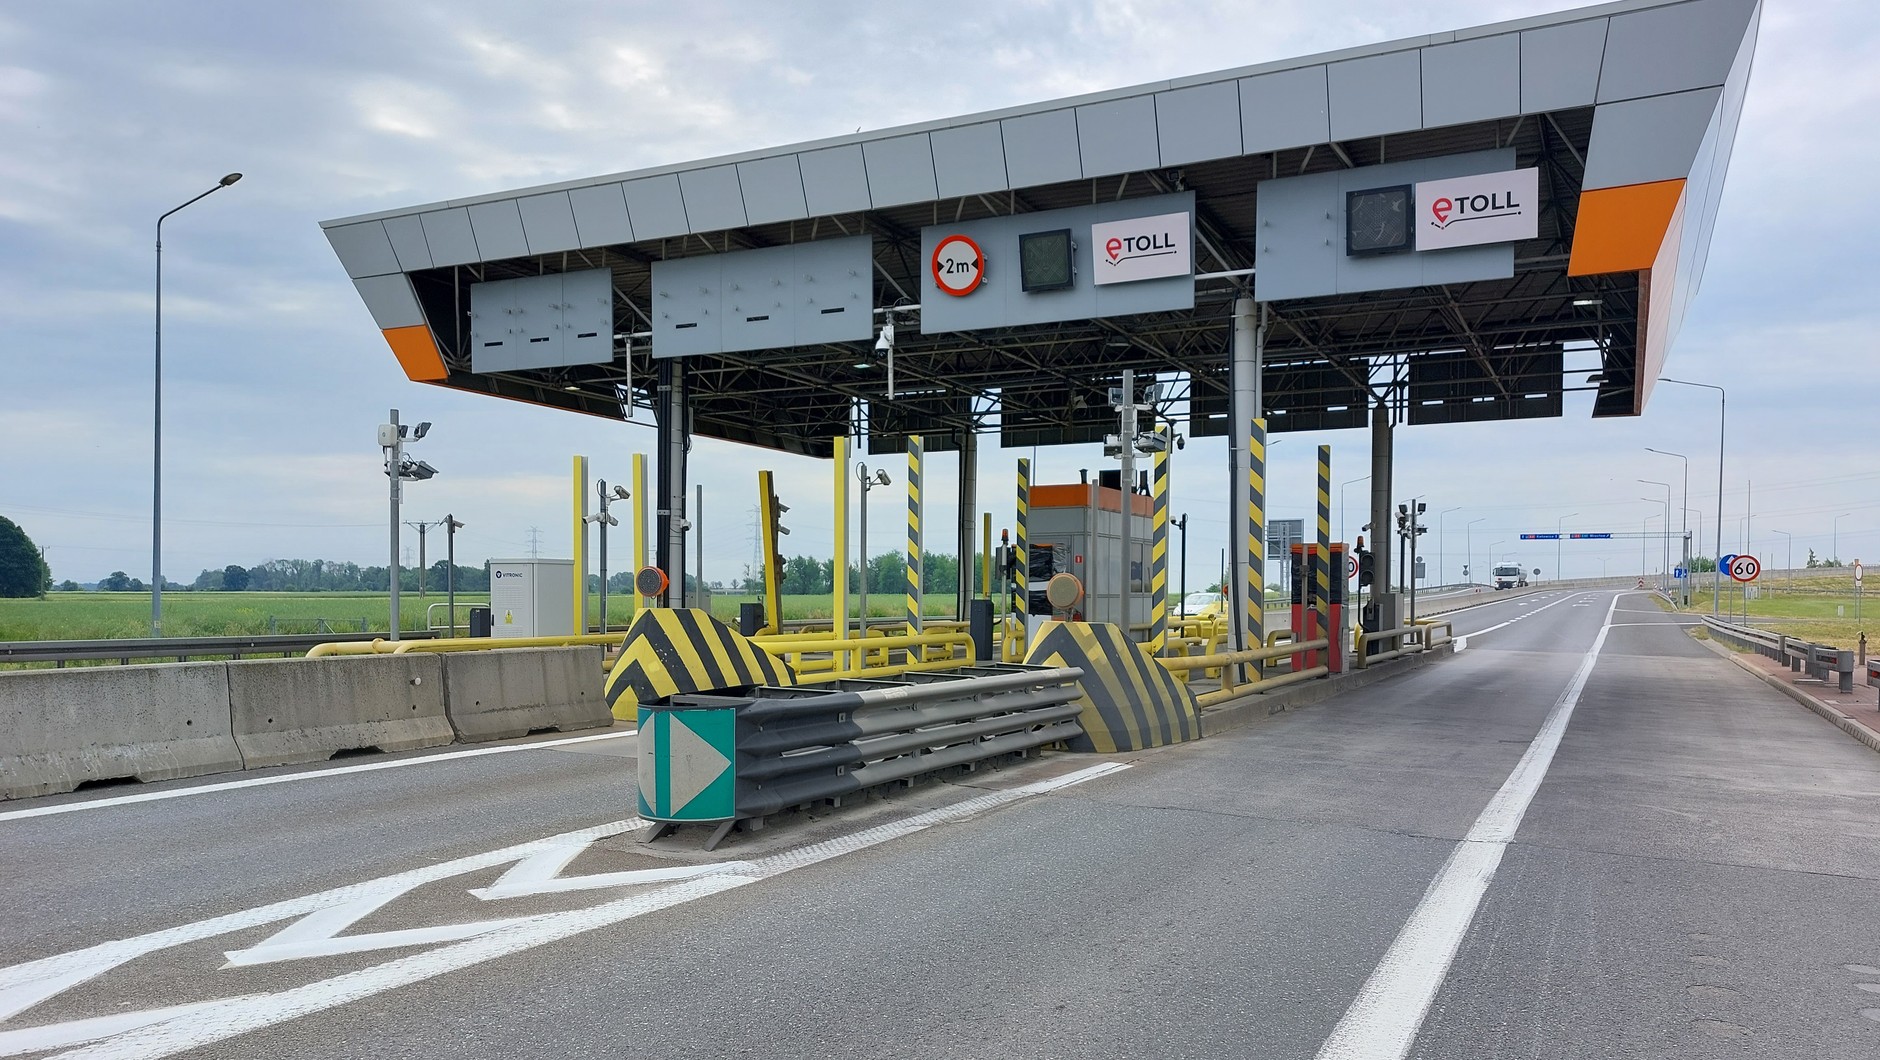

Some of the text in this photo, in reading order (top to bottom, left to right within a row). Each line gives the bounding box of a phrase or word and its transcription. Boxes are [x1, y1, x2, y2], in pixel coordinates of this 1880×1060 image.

[1432, 191, 1520, 224] eTOLL
[1105, 232, 1176, 261] eTOLL
[1734, 562, 1756, 575] 60
